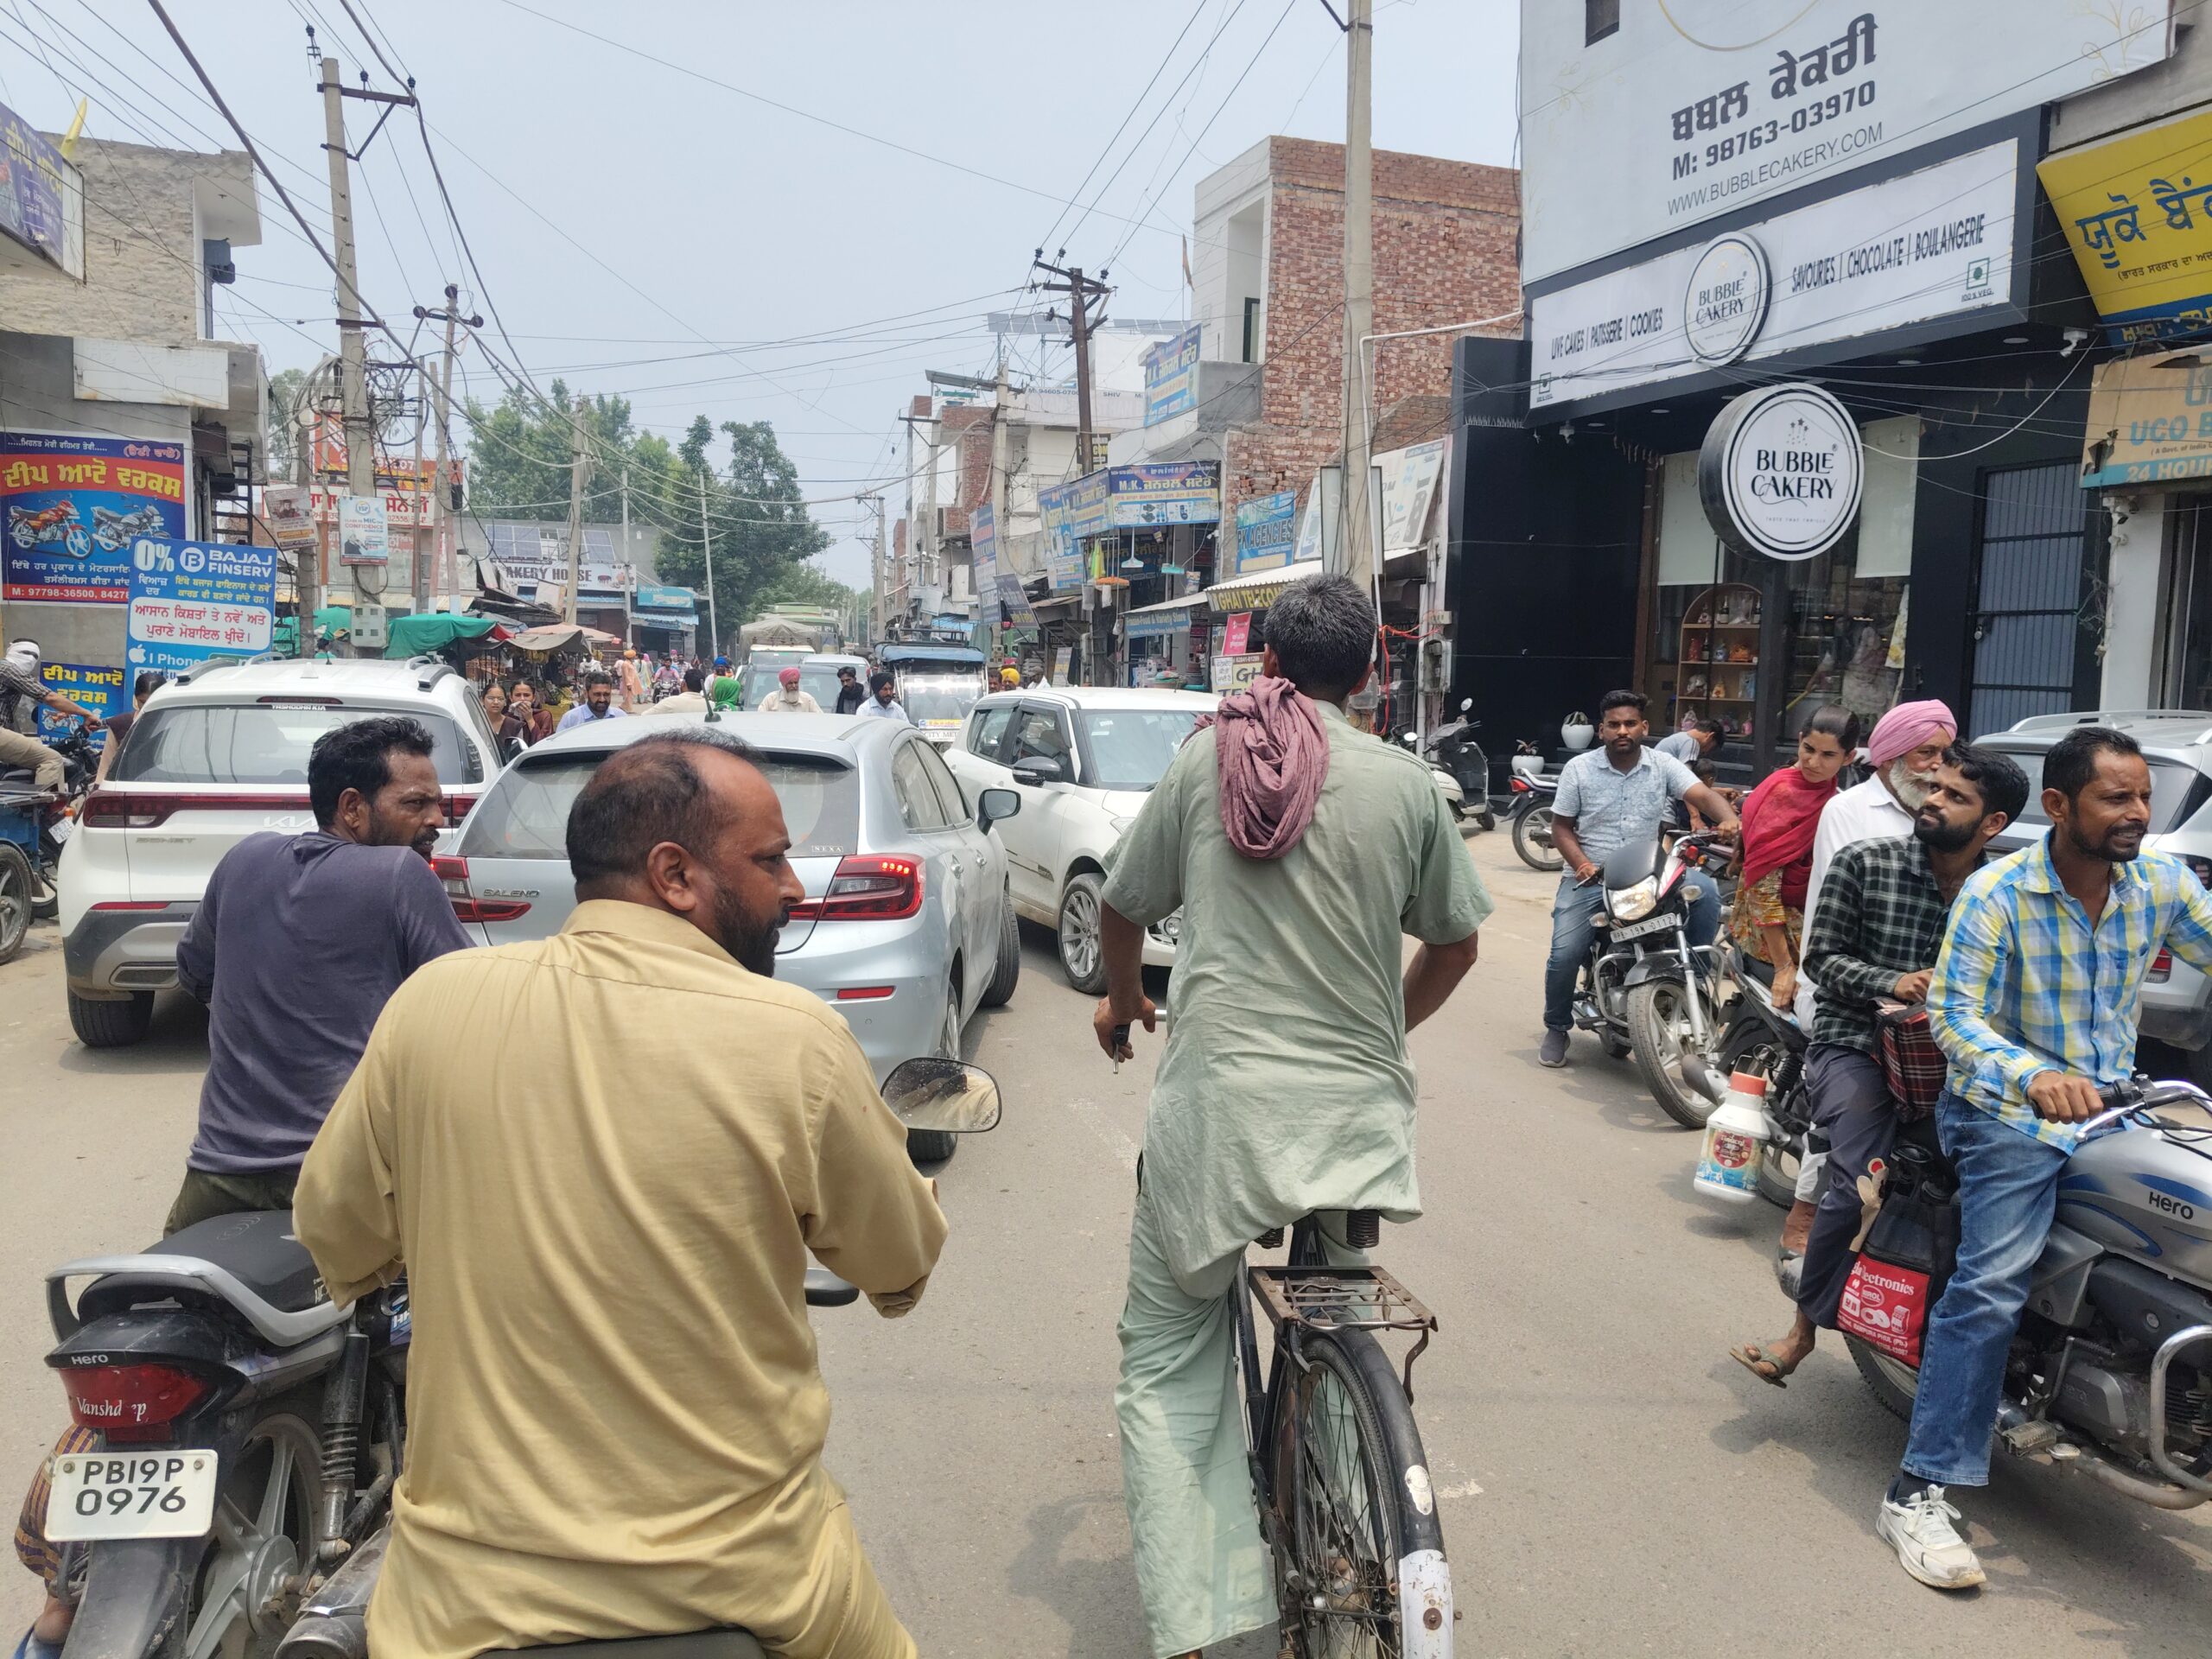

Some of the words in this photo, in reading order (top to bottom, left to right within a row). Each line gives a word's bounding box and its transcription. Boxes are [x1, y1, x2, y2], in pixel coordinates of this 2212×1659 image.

[1670, 80, 1751, 141] ਬਬਲ
[1769, 13, 1879, 100] ਕੇਕਰੀ
[1673, 152, 1698, 181] M:
[1706, 79, 1876, 168] 98763-03970
[1668, 122, 1884, 216] WWW.BUBBLECAKERY.COM
[2075, 192, 2146, 269] ਯੂਕੋ
[1791, 257, 1834, 292] SAVOURIES
[1847, 238, 1904, 278] CHOCOLATE
[1915, 213, 1985, 261] BOULANGERIE
[1699, 277, 1745, 306] BUBBLE
[1696, 298, 1745, 326] CAKERY
[1565, 328, 1585, 356] CAKES
[1590, 318, 1623, 346] PATISSERIE
[1630, 308, 1663, 337] COOKIES
[2130, 415, 2189, 447] UCO
[1757, 449, 1834, 474] BUBBLE
[2126, 464, 2151, 483] 24
[3, 461, 49, 488] ਦੀਪ
[57, 458, 107, 485] ਆਟੋ
[116, 466, 181, 499] ਵਰਕਸ
[1119, 480, 1142, 491] M.K.
[1143, 478, 1181, 490] ਜਨਰਲ
[1185, 474, 1211, 487] ਸਟੋਰ
[1751, 474, 1838, 505] CAKERY
[1249, 518, 1294, 547] AGENCIES
[78, 563, 86, 572] ਦੇ
[134, 539, 175, 572] 0%
[209, 550, 273, 565] BAJAJ
[208, 563, 272, 578] FINSERV
[505, 565, 548, 580] AKERY
[552, 568, 593, 582] HOSE
[11, 588, 25, 596] M:
[145, 587, 161, 596] ਦਰ
[1218, 591, 1243, 610] GHAI
[1242, 588, 1281, 608] TELECO
[135, 605, 170, 617] ਆਸਾਨ
[212, 607, 220, 622] ਤੇ
[225, 610, 244, 624] ਨਵੇਂ
[247, 612, 266, 626] ਅਤੇ
[146, 623, 175, 639] ਪੁਰਾਣੇ
[180, 623, 220, 641] ਮੋਬਾਇਲ
[43, 665, 78, 682] ਦੀਪ
[86, 669, 124, 686] ਆਟੋ
[483, 888, 540, 898] BALENO
[2148, 1192, 2194, 1220] Hero
[71, 1353, 109, 1365] Hero
[83, 1458, 186, 1485] PB19P
[75, 1486, 187, 1516] 0976
